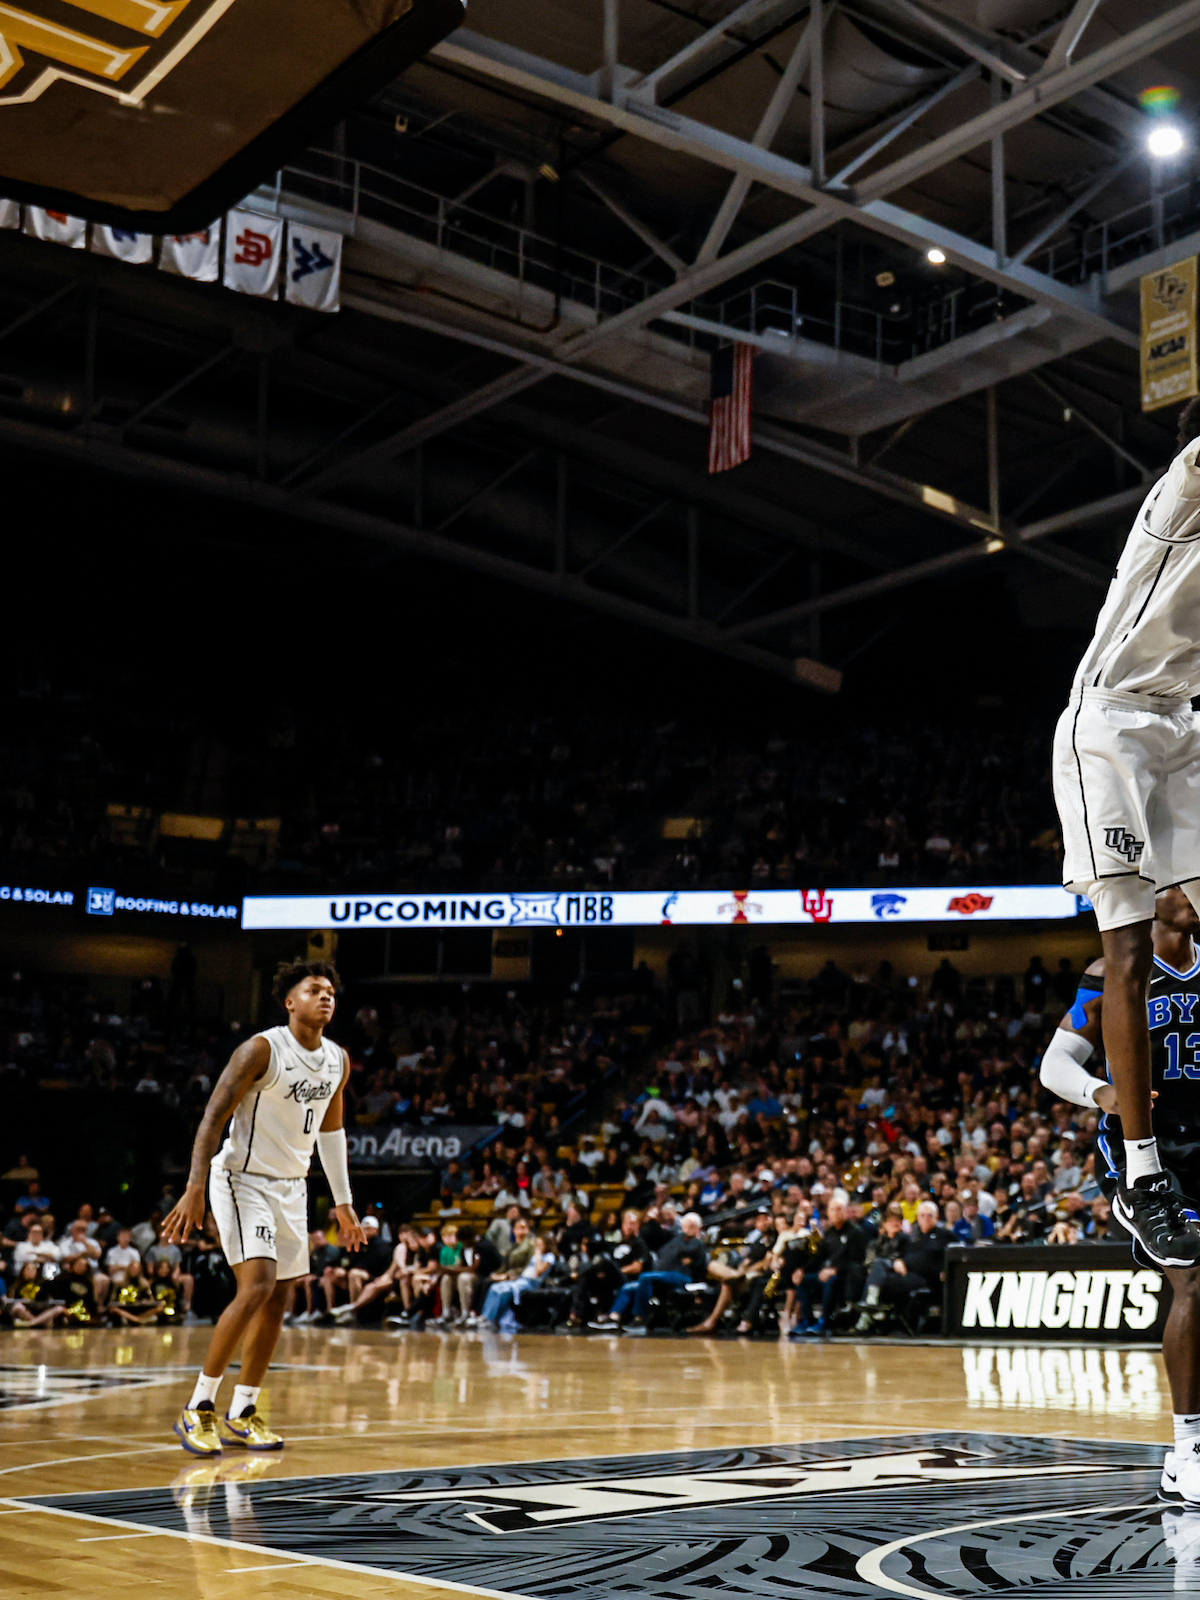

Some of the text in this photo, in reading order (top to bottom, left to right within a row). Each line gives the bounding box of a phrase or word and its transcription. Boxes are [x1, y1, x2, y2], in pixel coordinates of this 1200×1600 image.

[1103, 827, 1145, 863] UCF
[23, 886, 75, 905] SOLAR
[115, 896, 179, 915] ROOFING
[190, 902, 238, 919] SOLAR
[330, 900, 505, 921] UPCOMING
[565, 896, 613, 924] MBB
[378, 1128, 461, 1158] Arena
[961, 1269, 1162, 1330] KNIGHTS
